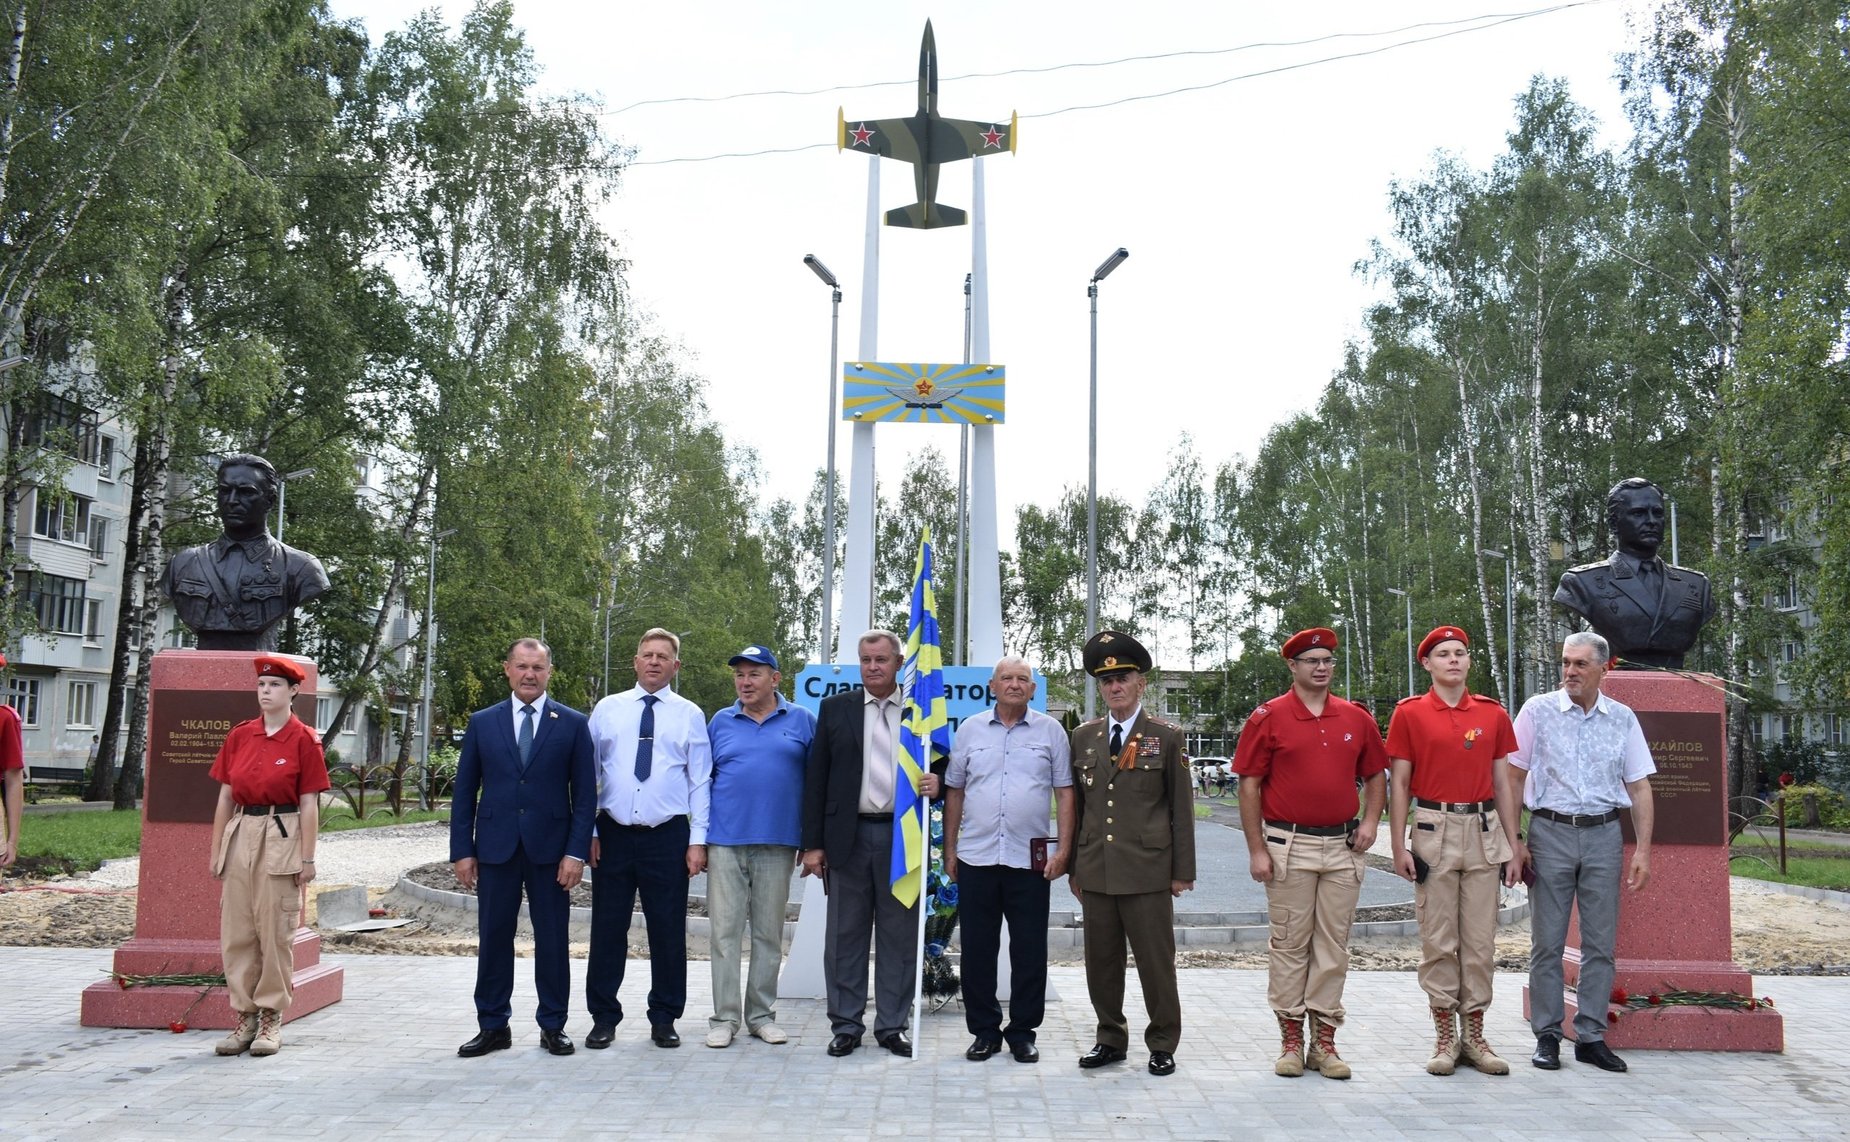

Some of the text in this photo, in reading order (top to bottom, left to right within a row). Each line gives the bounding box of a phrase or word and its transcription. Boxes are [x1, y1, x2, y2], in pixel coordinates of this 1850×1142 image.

[181, 720, 231, 730] ЧКАЛОВ
[169, 731, 228, 740] Валерий Павло
[1648, 739, 1703, 752] ХАЙЛОВ
[1668, 754, 1709, 762] Сергеевич
